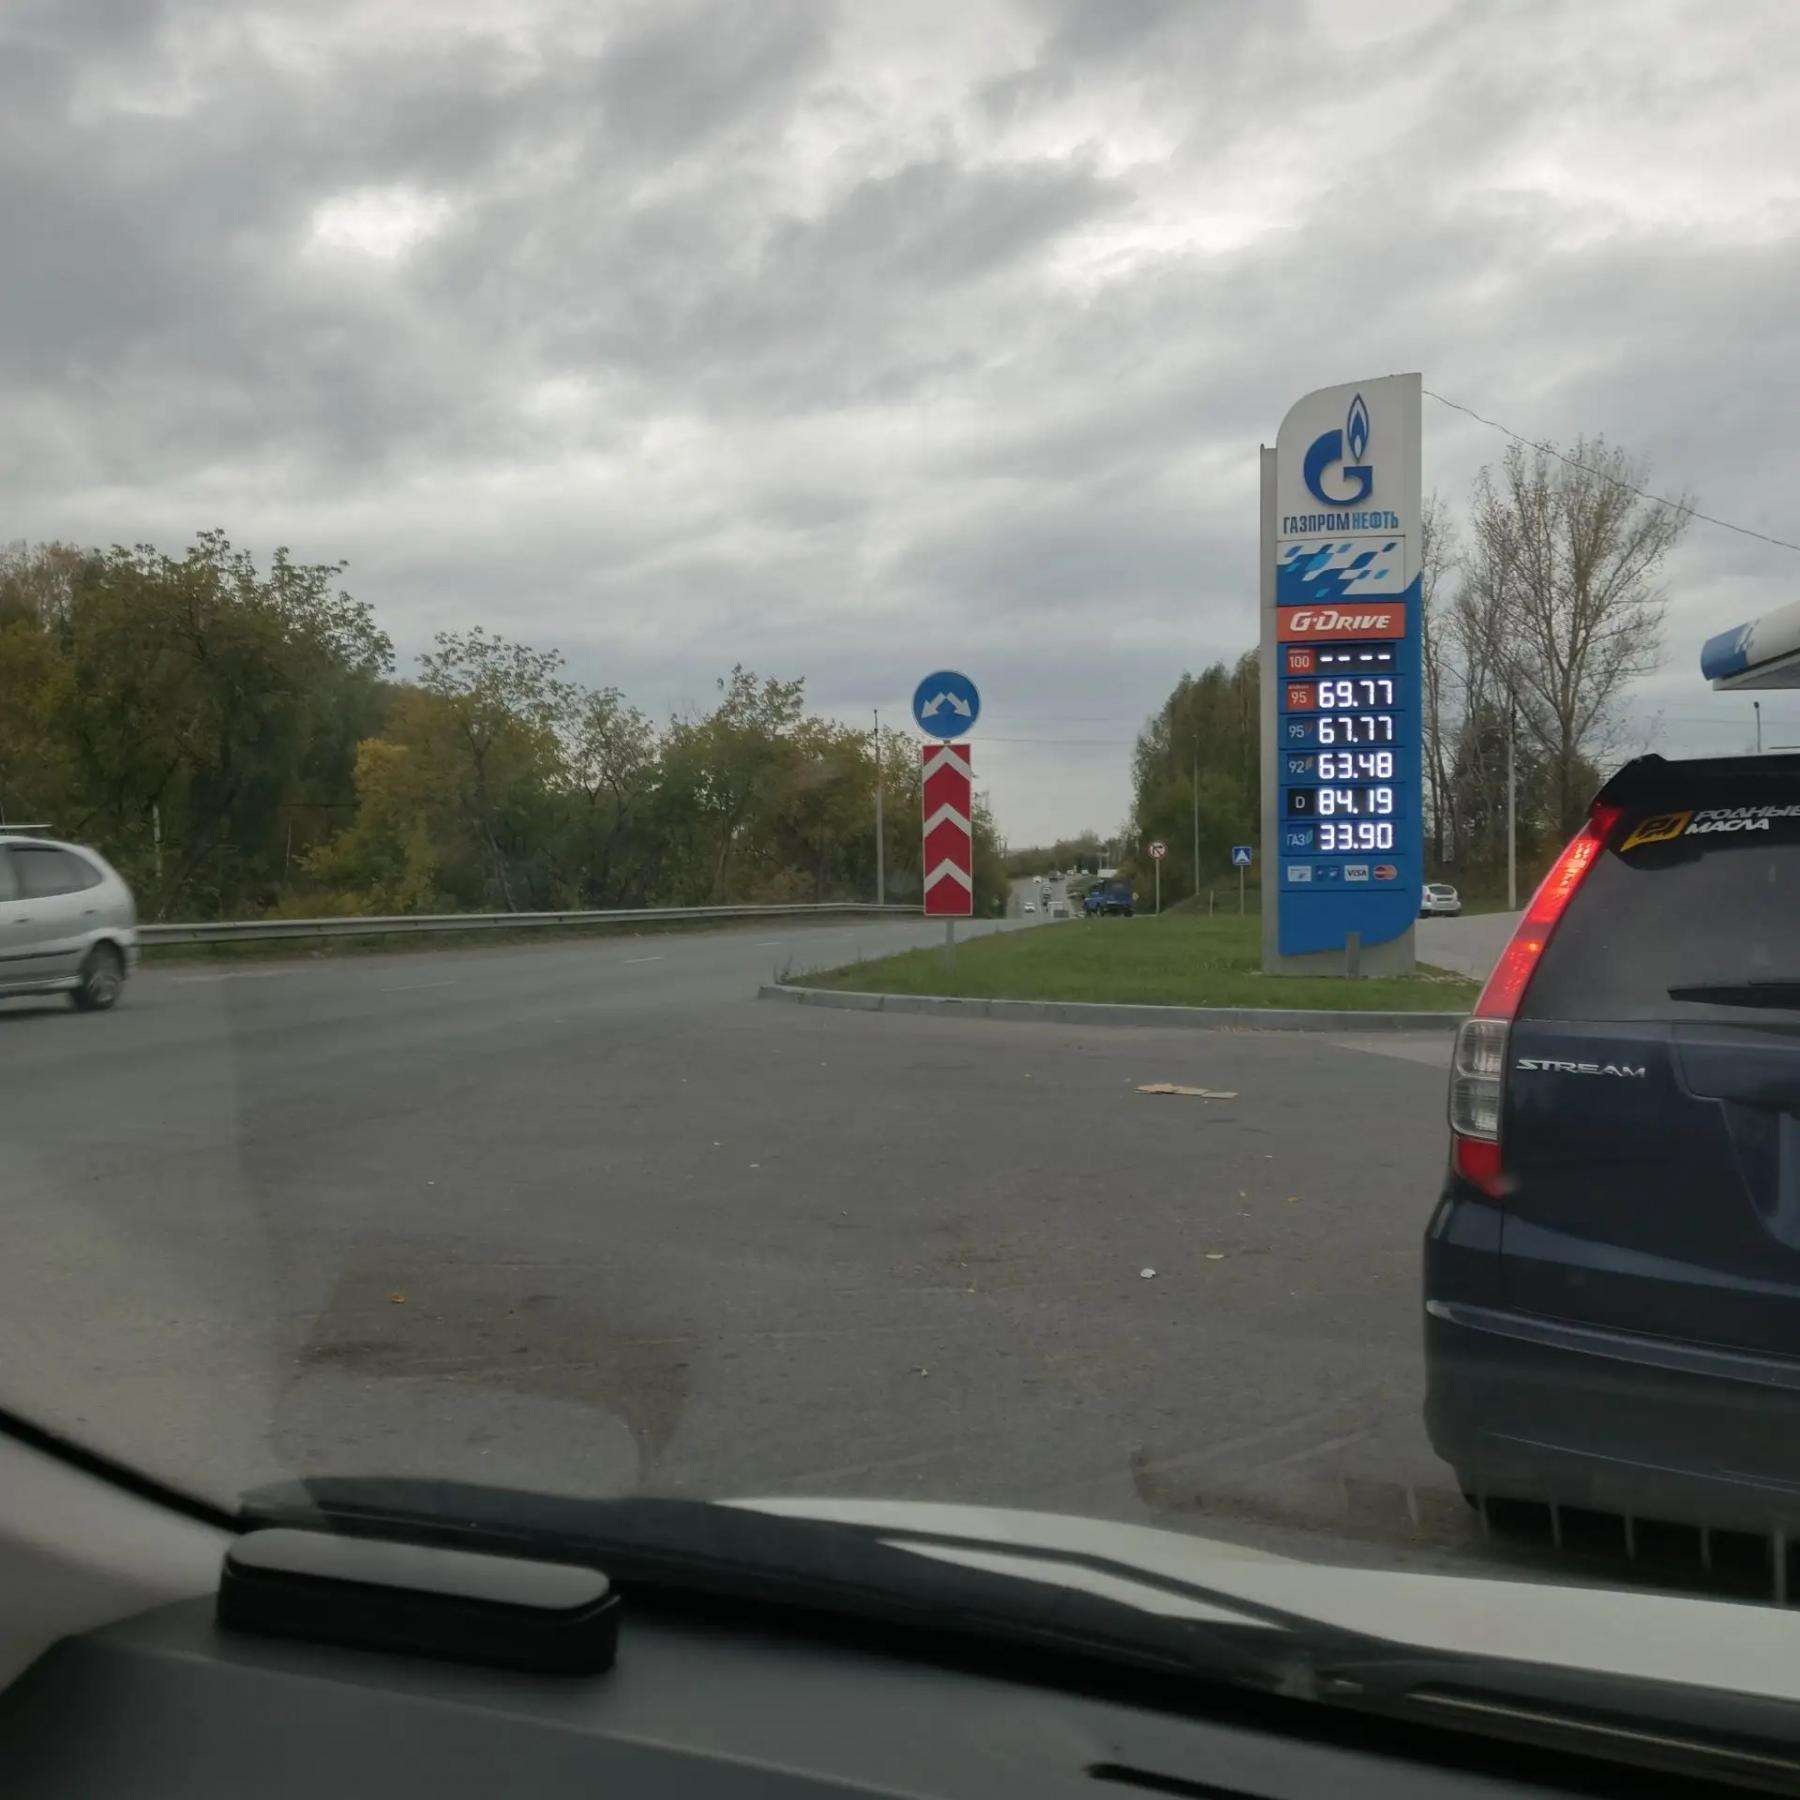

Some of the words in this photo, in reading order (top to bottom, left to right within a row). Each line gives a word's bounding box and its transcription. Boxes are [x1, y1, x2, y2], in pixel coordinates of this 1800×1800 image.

[1283, 511, 1399, 534] ГАЗПРОМНЕФТЬ
[1289, 656, 1310, 669] 100
[1291, 691, 1307, 704] 95
[1318, 680, 1393, 708] 69.77
[1288, 725, 1305, 738] 95
[1318, 716, 1393, 744] 67.77
[1288, 760, 1305, 774] 92
[1318, 752, 1393, 779] 63.48
[1295, 796, 1306, 809] D
[1318, 787, 1393, 815] 84.19
[1287, 833, 1306, 846] ГАЗ
[1319, 823, 1393, 850] 33.90
[1684, 818, 1770, 835] МАСЛА
[1346, 869, 1367, 877] VISA
[1515, 1059, 1646, 1078] STREAM
